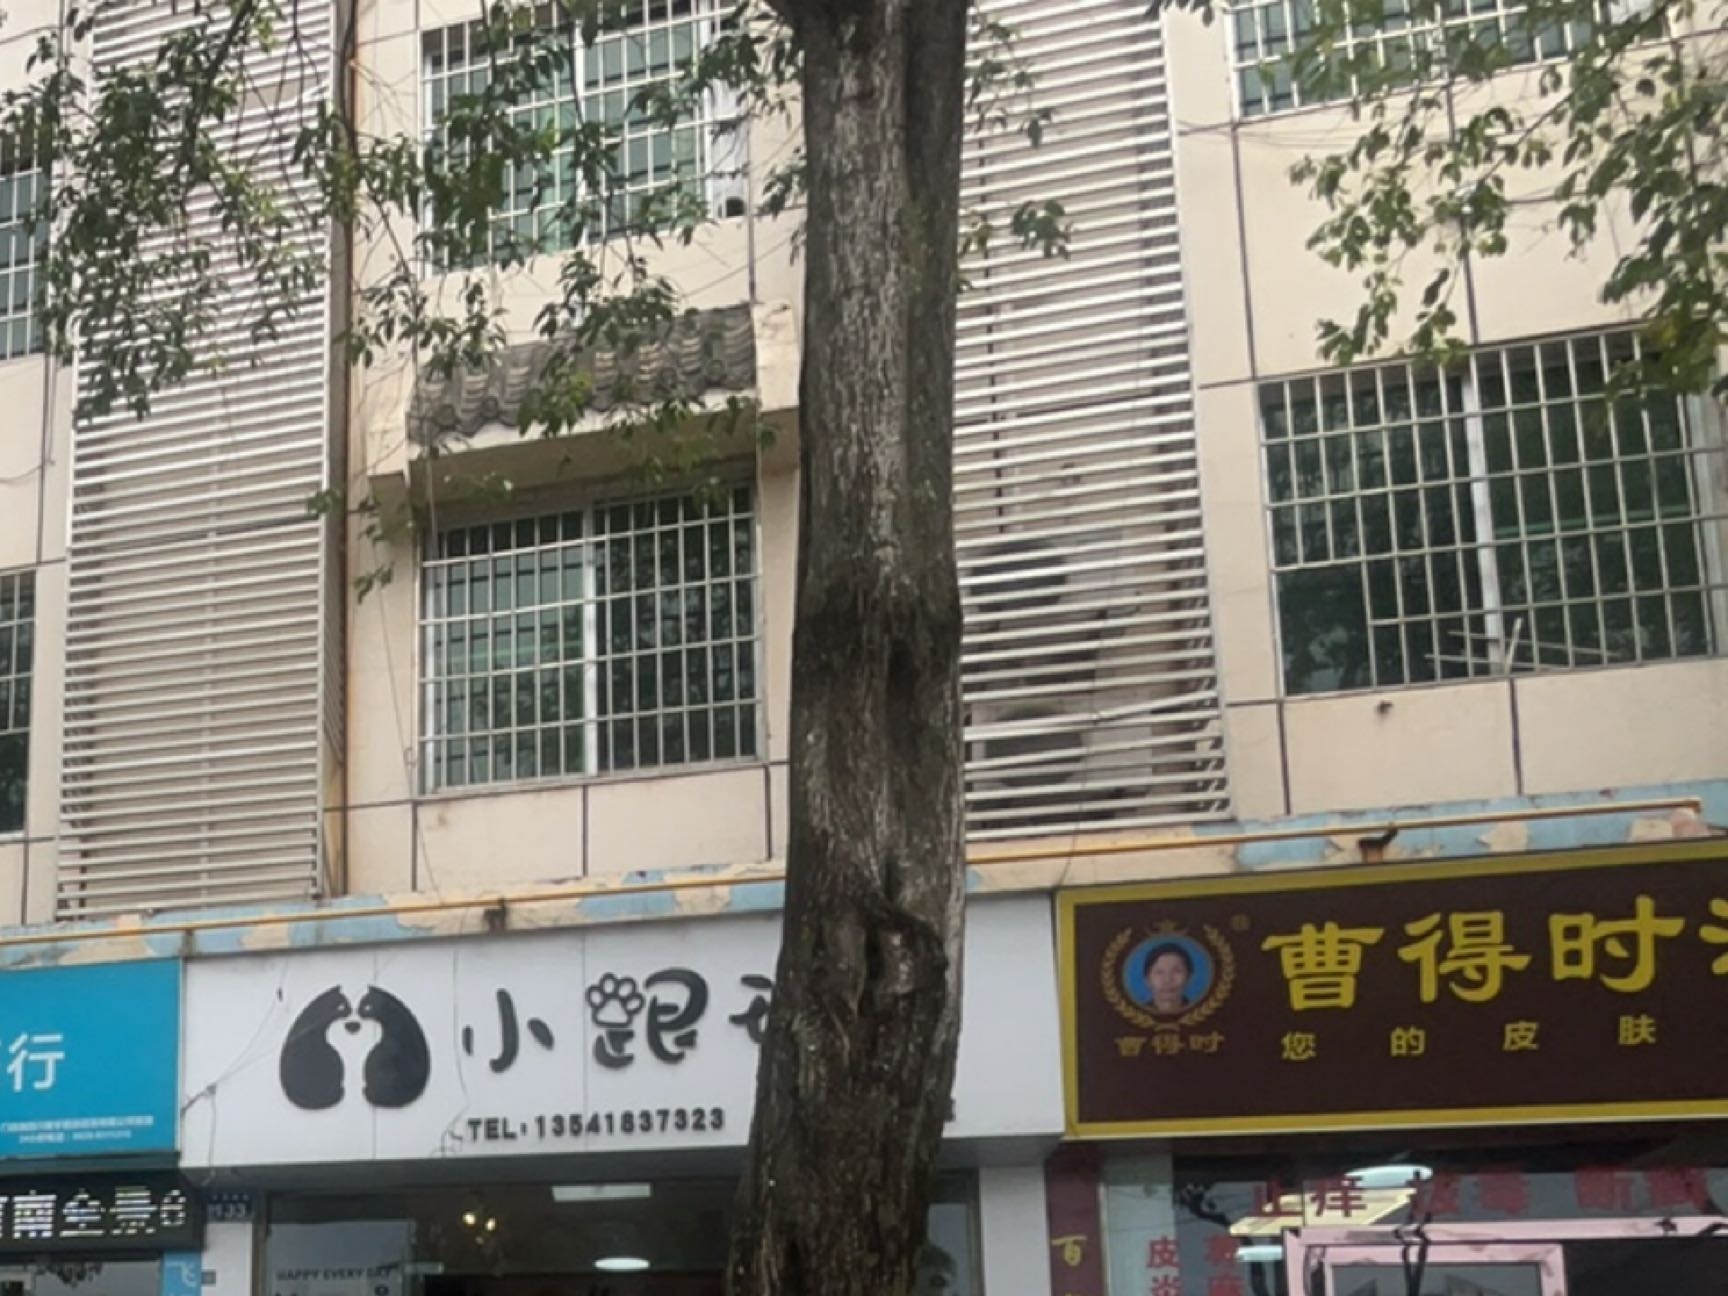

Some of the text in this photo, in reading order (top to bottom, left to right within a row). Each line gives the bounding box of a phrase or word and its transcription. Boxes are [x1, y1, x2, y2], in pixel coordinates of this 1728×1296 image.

[1260, 894, 1728, 1011] 曹得时
[1281, 1014, 1657, 1061] 您的皮肤
